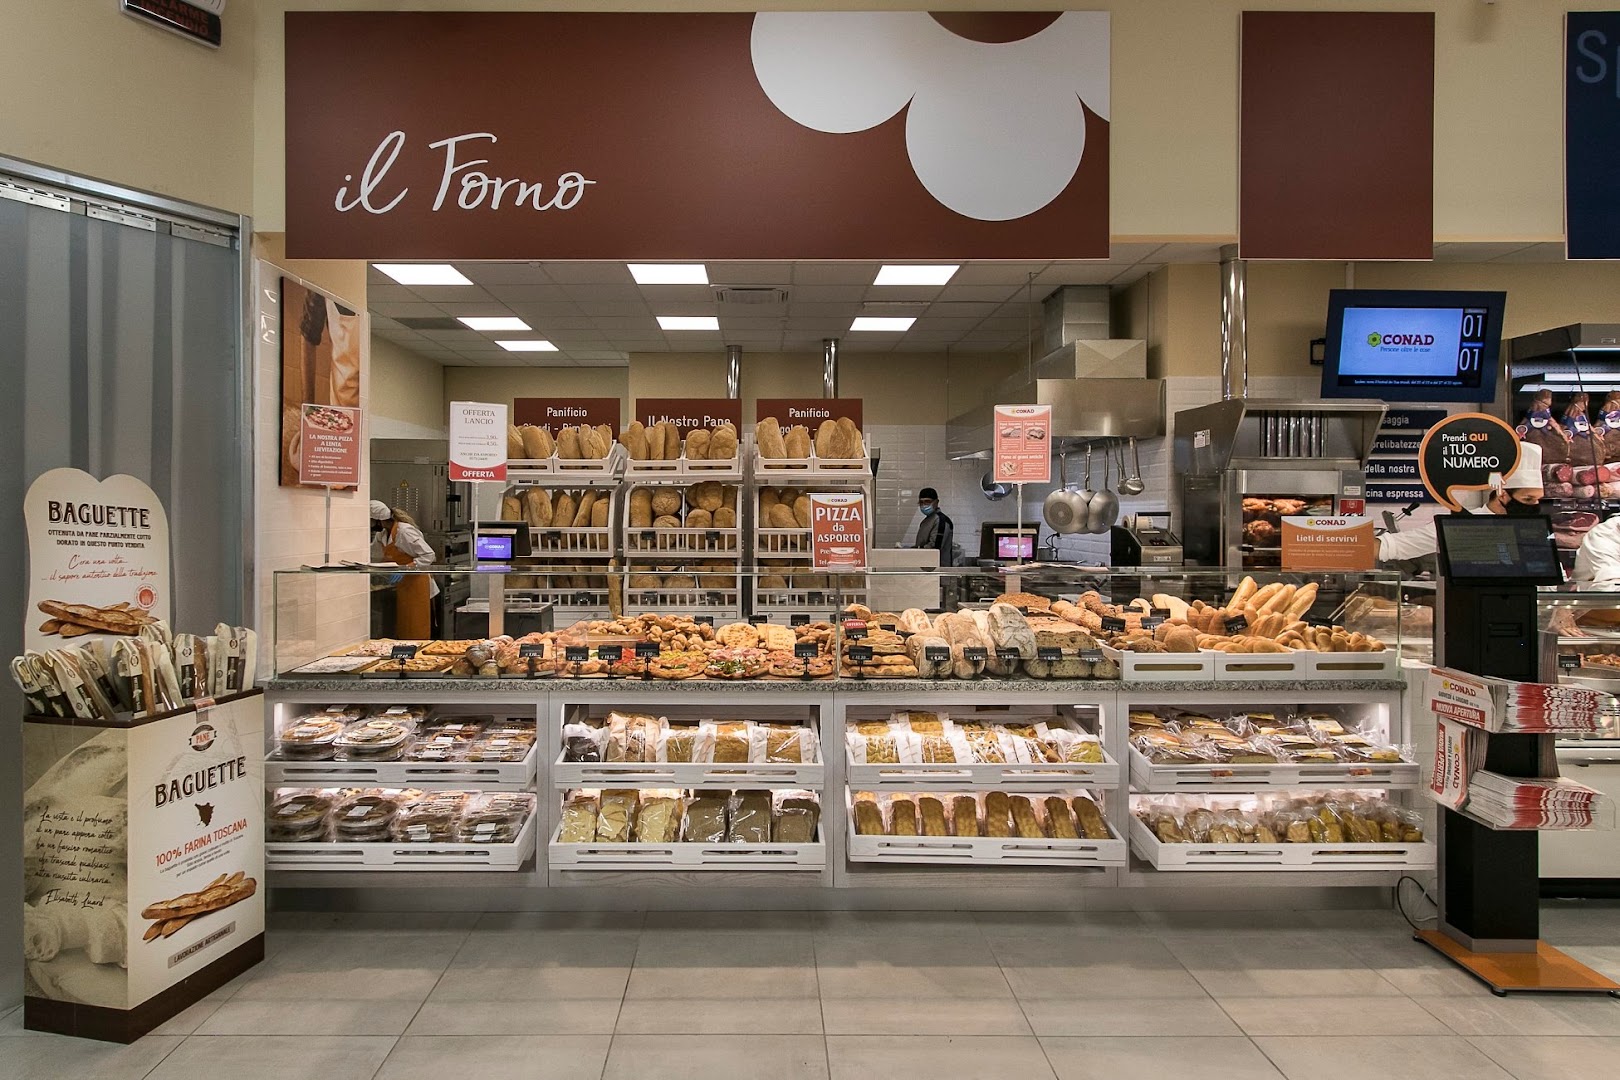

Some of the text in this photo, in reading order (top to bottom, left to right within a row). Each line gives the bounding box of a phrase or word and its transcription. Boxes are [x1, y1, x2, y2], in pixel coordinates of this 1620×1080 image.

[1576, 30, 1620, 98] S
[334, 130, 596, 213] il Forno
[1463, 315, 1482, 337] 01
[1382, 334, 1434, 346] CONAD
[1460, 348, 1479, 370] 01
[547, 407, 588, 417] Panificio
[789, 408, 830, 418] Panificio
[1382, 416, 1410, 426] saggia
[1442, 432, 1488, 442] Prendi QUI
[1442, 444, 1476, 456] il TUO
[1364, 464, 1415, 473] della nostra
[1443, 456, 1500, 469] NUMERO
[1366, 488, 1383, 498] cina
[1386, 490, 1424, 500] espressa
[48, 500, 151, 530] BAGUETTE
[815, 507, 862, 522] PIZZA
[832, 522, 845, 532] da
[48, 530, 76, 538] OTTENUTA
[100, 532, 136, 540] PARZIALMENTE
[817, 534, 861, 543] ASPORTO
[1296, 534, 1358, 543] Lieti di servirvi
[1450, 682, 1476, 697] CONAD
[1435, 702, 1452, 715] NUOVA
[1453, 704, 1480, 721] APERTURA
[196, 732, 210, 744] PANE
[1436, 752, 1444, 788] APERTURA
[155, 756, 246, 808] BAGUETTE
[76, 810, 84, 822] il
[84, 813, 112, 827] profumo
[54, 829, 70, 838] pane
[98, 830, 116, 840] cotto
[156, 847, 182, 866] 100%
[184, 834, 212, 854] FARINA
[214, 818, 248, 841] TOSCANA
[82, 844, 113, 854] romantico
[46, 888, 106, 910] Elisabeth Luard
[174, 940, 204, 964] LAVORAZIONE
